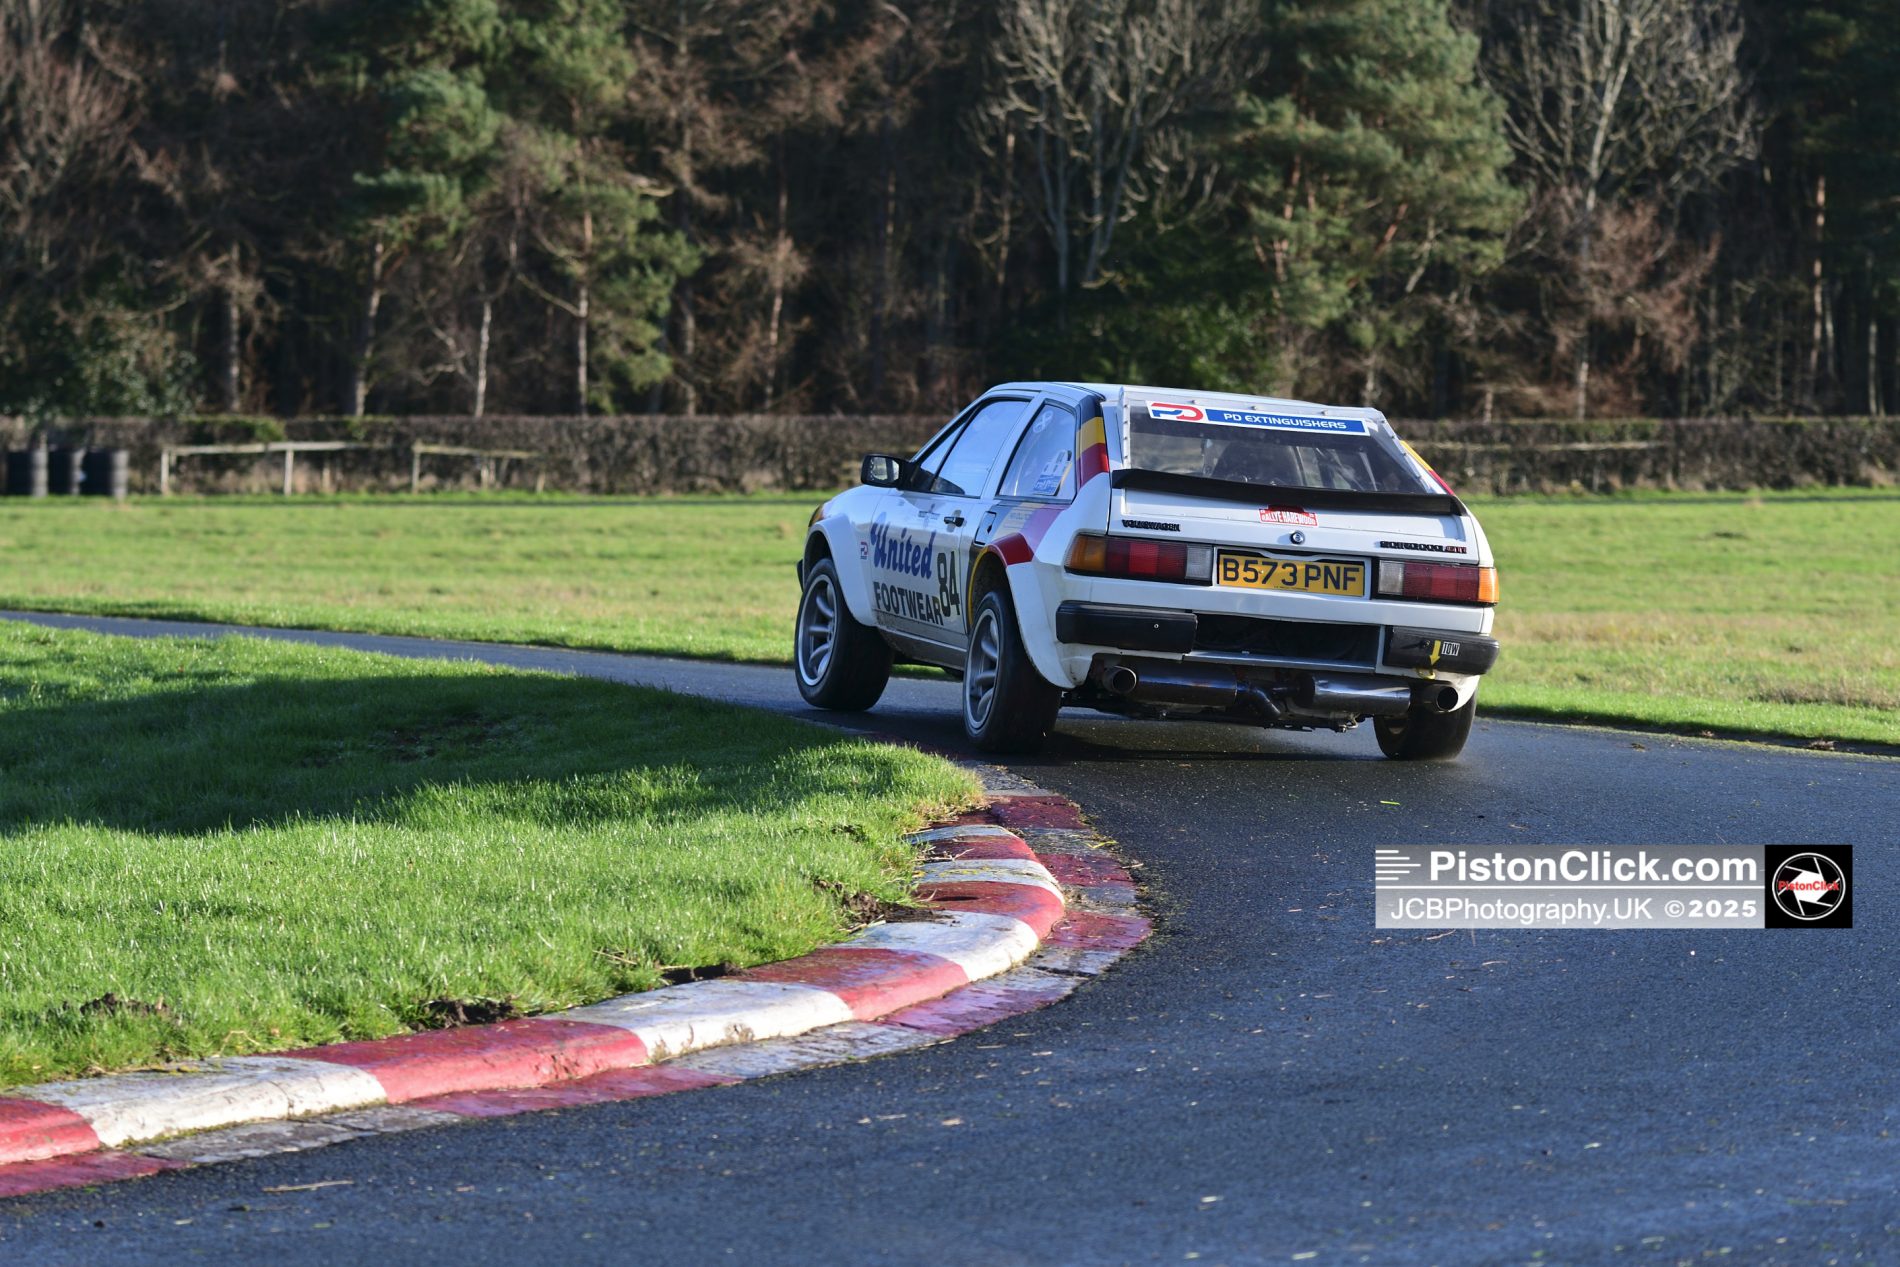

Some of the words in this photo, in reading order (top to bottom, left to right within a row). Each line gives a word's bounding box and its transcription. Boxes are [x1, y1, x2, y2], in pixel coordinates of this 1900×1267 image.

[1223, 413, 1242, 422] PD
[1246, 415, 1346, 429] EXTINGUISHERS
[870, 519, 936, 579] United
[938, 551, 960, 617] 84
[1223, 558, 1298, 586] B573
[1304, 564, 1360, 591] PNF
[873, 581, 944, 626] FOOTWEAR
[1442, 642, 1459, 655] TOW
